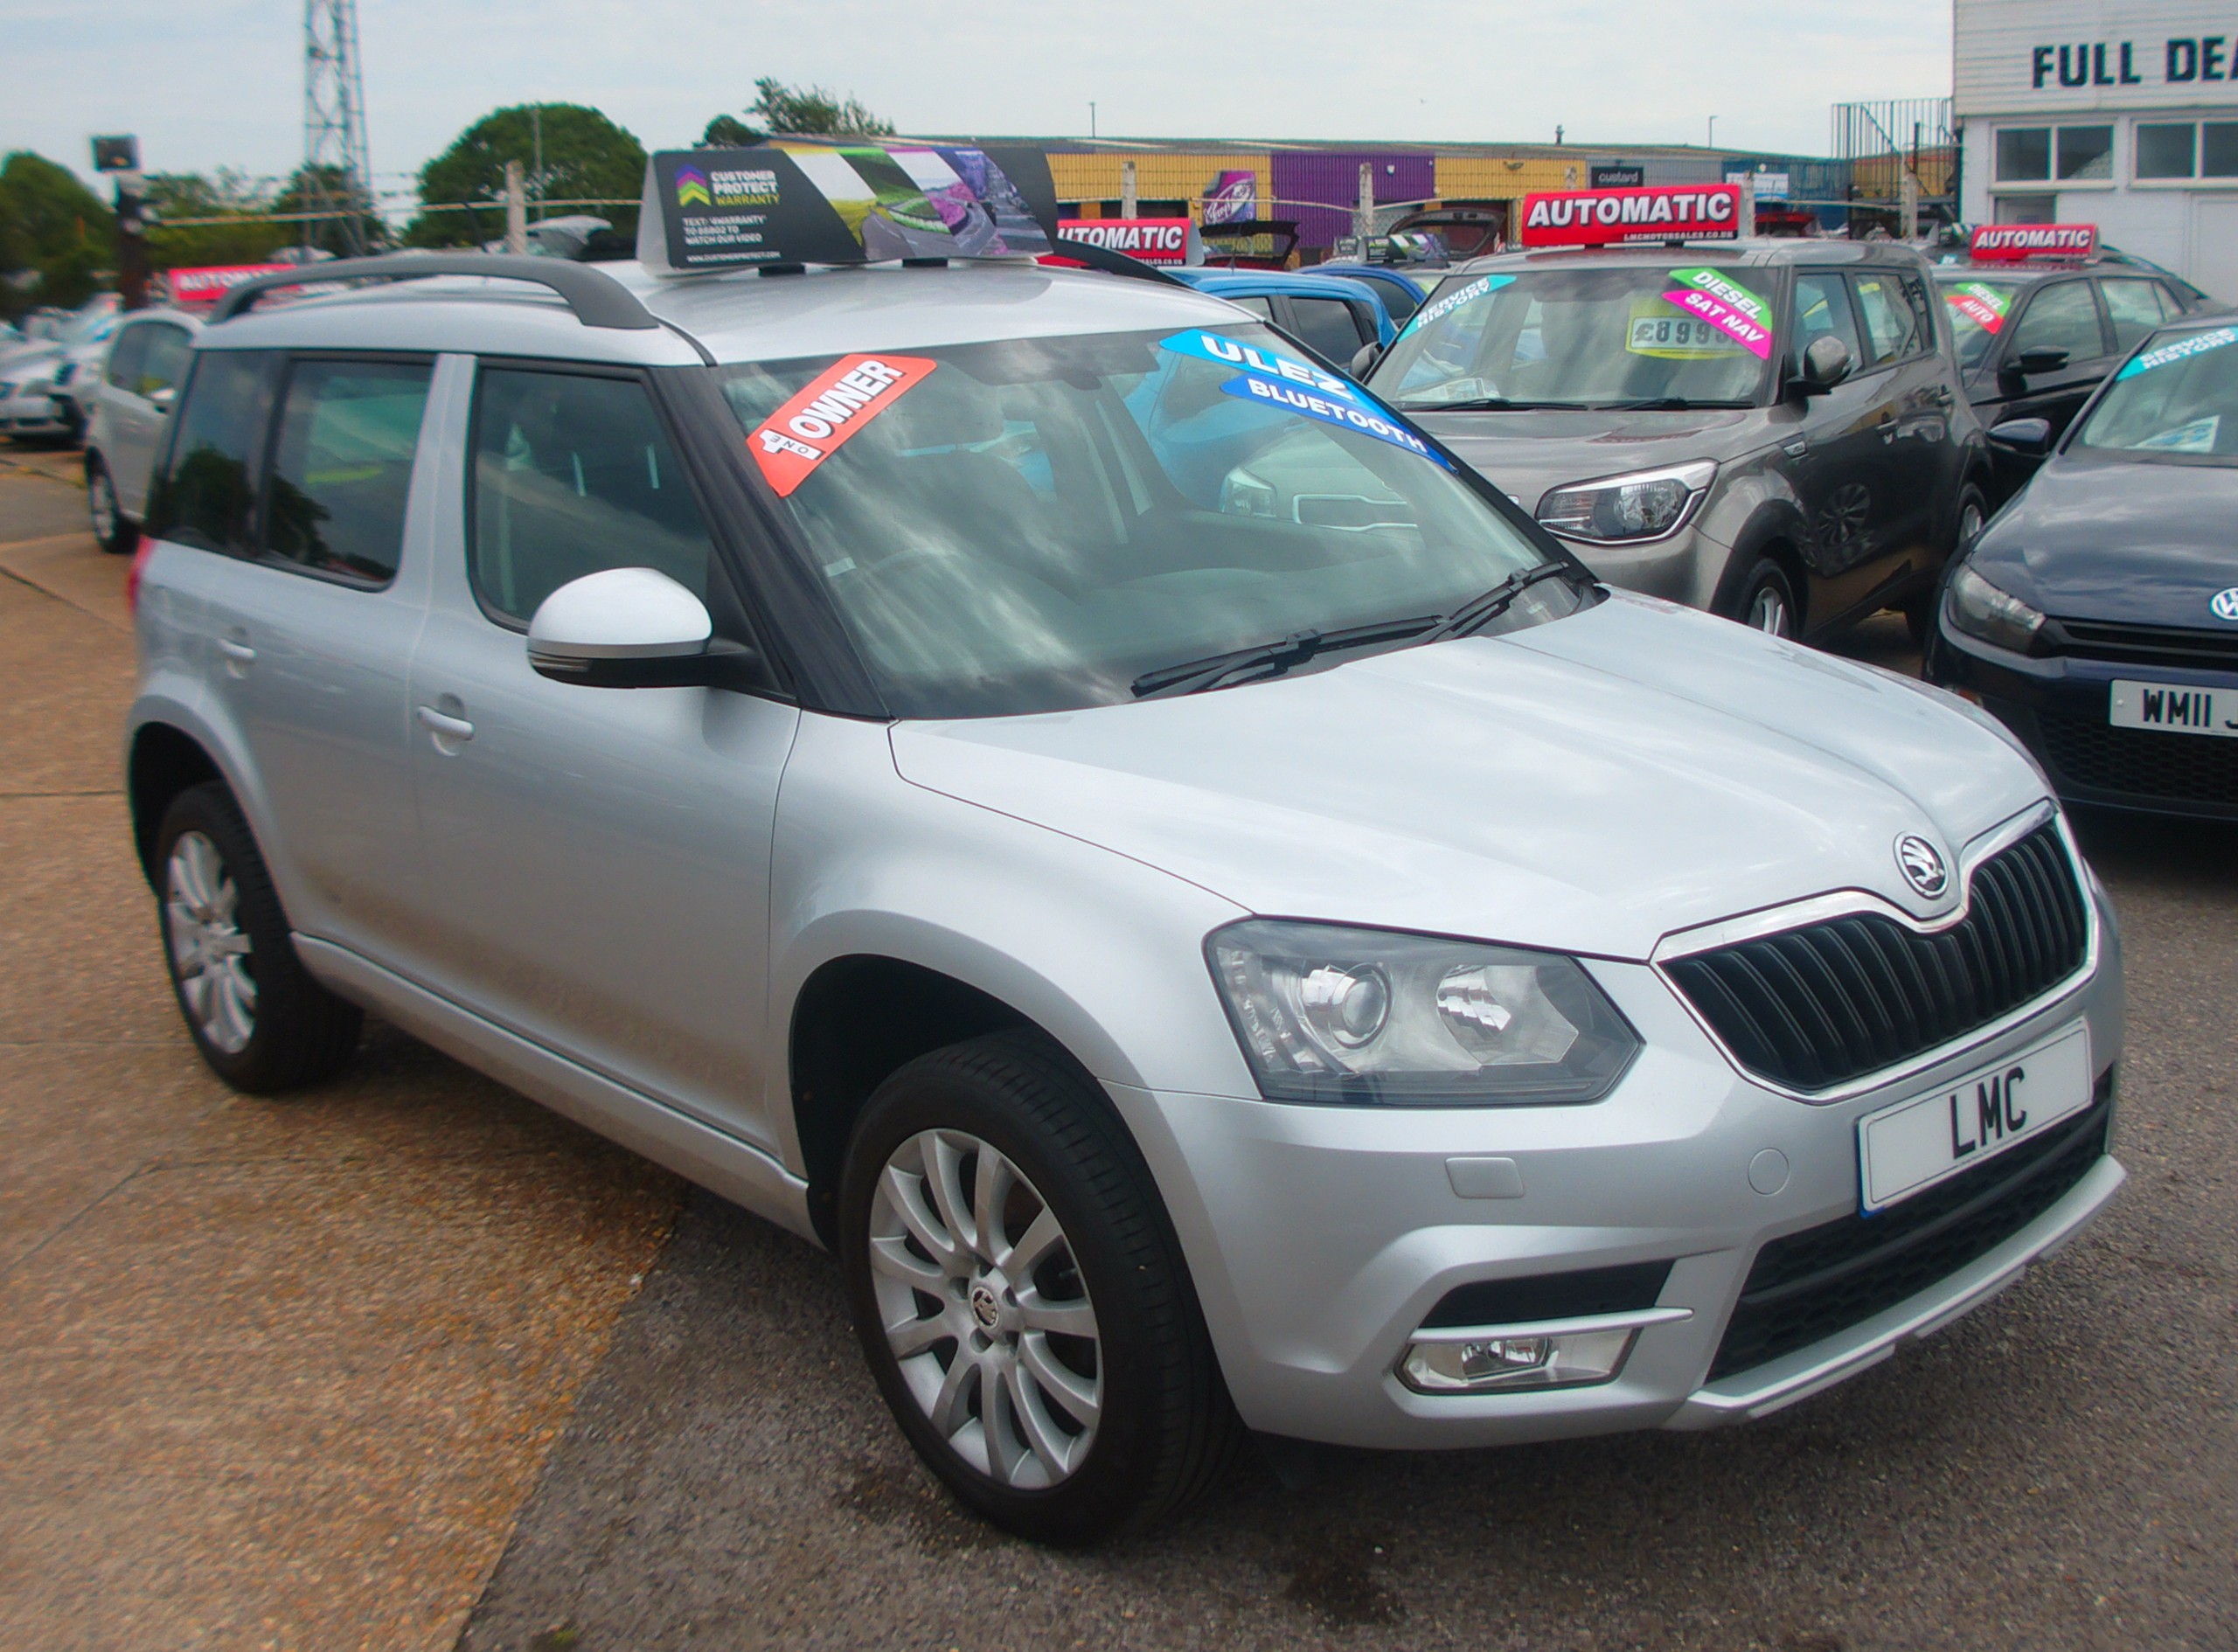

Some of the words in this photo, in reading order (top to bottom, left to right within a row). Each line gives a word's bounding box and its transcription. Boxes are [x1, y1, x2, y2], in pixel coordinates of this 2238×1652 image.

[2033, 41, 2142, 88] FULL
[712, 181, 778, 194] PROTECT
[715, 194, 780, 206] WARRANTY
[1527, 192, 1732, 226] AUTOMATIC
[685, 235, 715, 245] WATCH
[736, 233, 763, 243] VIDEO
[726, 226, 740, 234] TO
[1058, 226, 1183, 251] UTOMATIC
[1975, 229, 2091, 249] AUTOMATIC
[1417, 277, 1487, 321] SERVICE
[1417, 282, 1491, 328] HISTORY
[1692, 271, 1762, 320] DIESEL
[1961, 300, 1995, 323] AUTO
[1968, 283, 2004, 310] DIESEL
[1685, 293, 1726, 316] SAT
[1721, 316, 1765, 342] NAV
[1200, 335, 1354, 400] ULEZ
[789, 360, 905, 440] OWNER
[1247, 378, 1428, 453] BLUETOOTH
[2143, 688, 2213, 727] WM11
[1950, 1065, 2027, 1160] LMC
